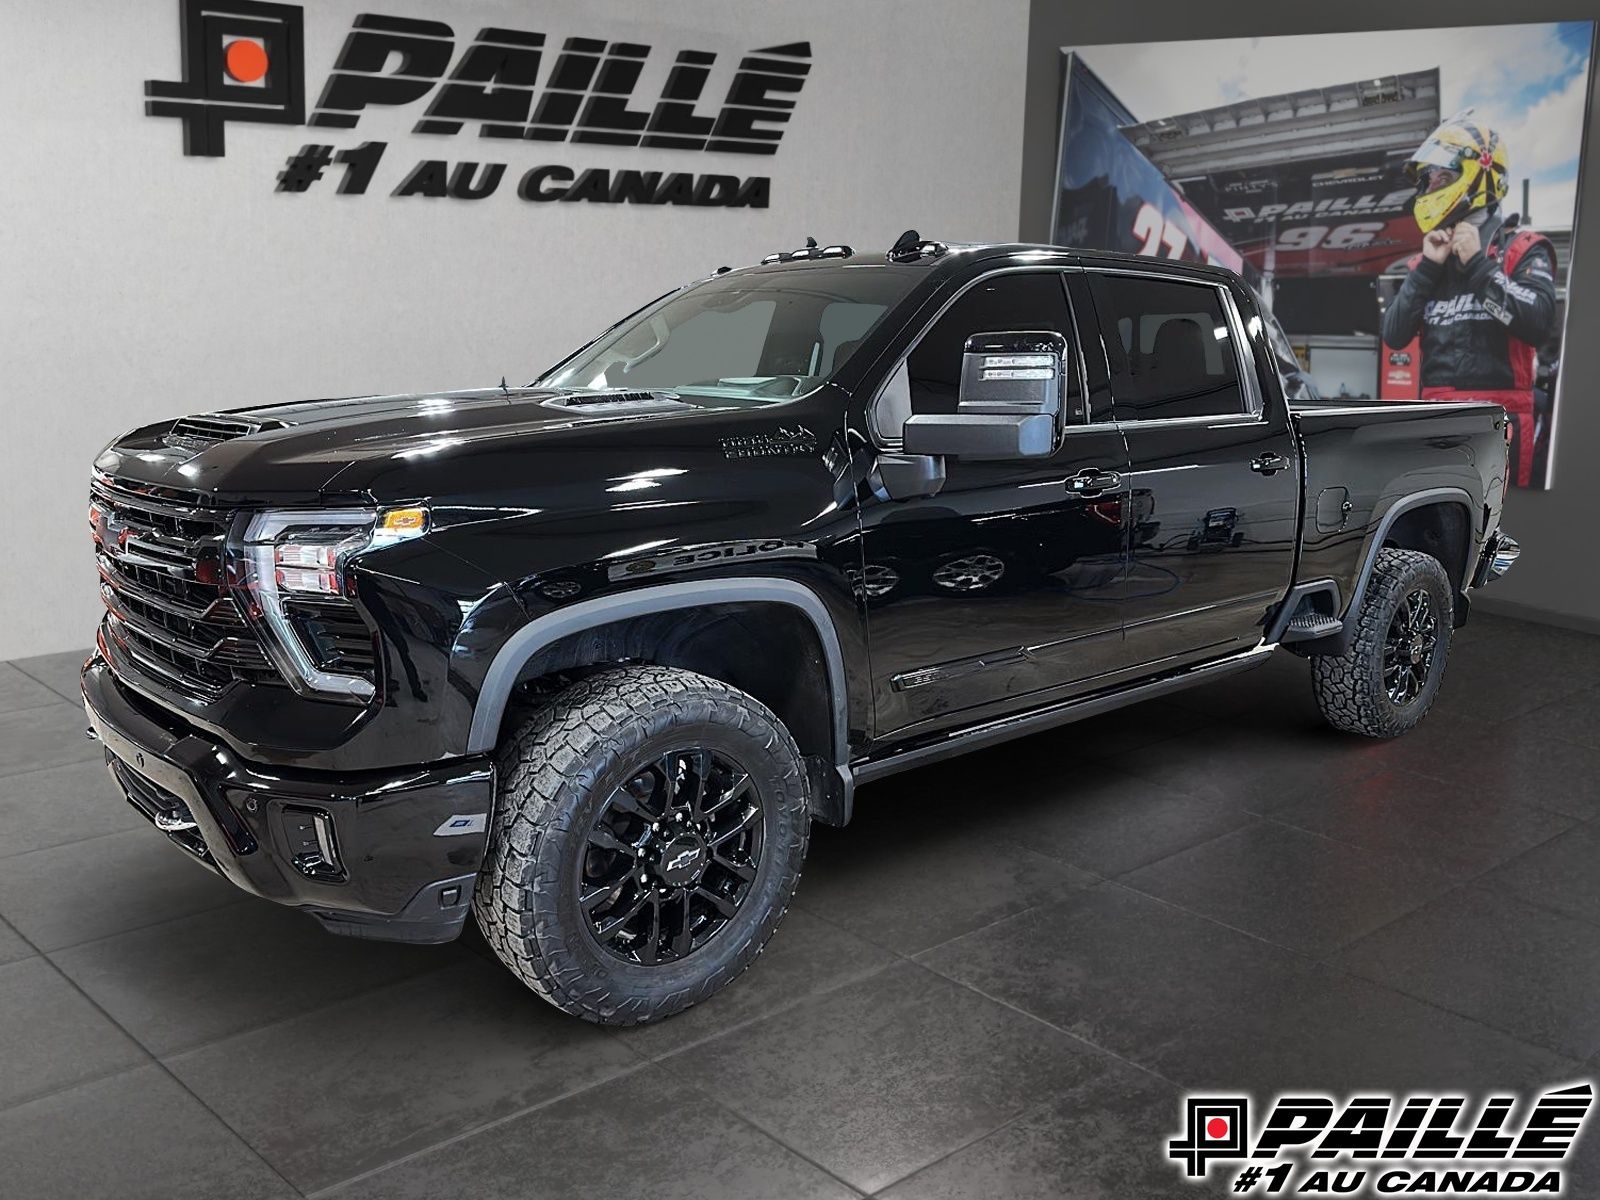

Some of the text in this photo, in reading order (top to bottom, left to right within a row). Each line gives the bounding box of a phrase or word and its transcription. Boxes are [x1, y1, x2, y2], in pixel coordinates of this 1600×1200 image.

[307, 13, 812, 155] PAILLÉ
[274, 141, 771, 208] #1 AU CANADA
[1312, 175, 1385, 187] CHEVROLET
[1314, 206, 1404, 218] CANADA
[1274, 222, 1386, 251] 96
